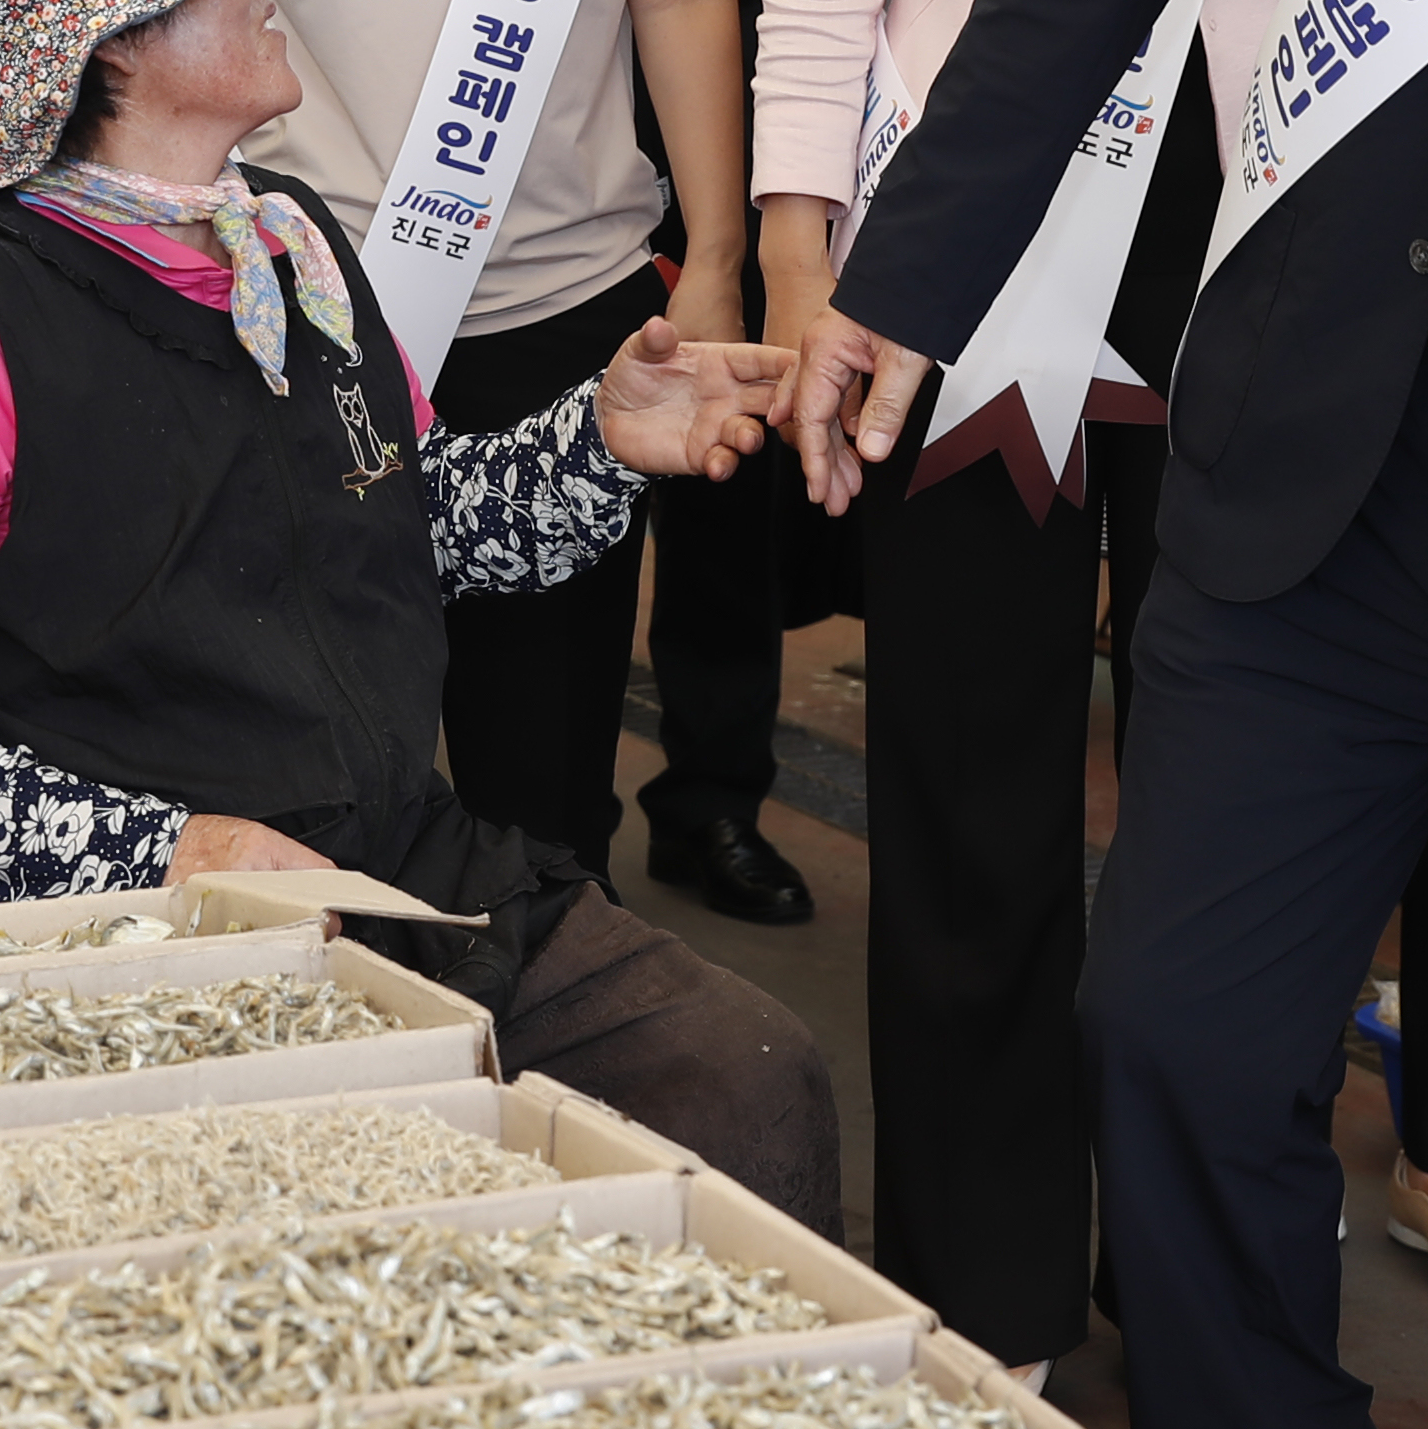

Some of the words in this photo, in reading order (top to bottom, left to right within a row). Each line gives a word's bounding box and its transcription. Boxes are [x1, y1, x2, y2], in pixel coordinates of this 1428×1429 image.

[435, 13, 535, 176] 캠페인
[1074, 132, 1134, 169] 도군
[390, 185, 475, 226] Jindo
[391, 216, 472, 260] 진도군
